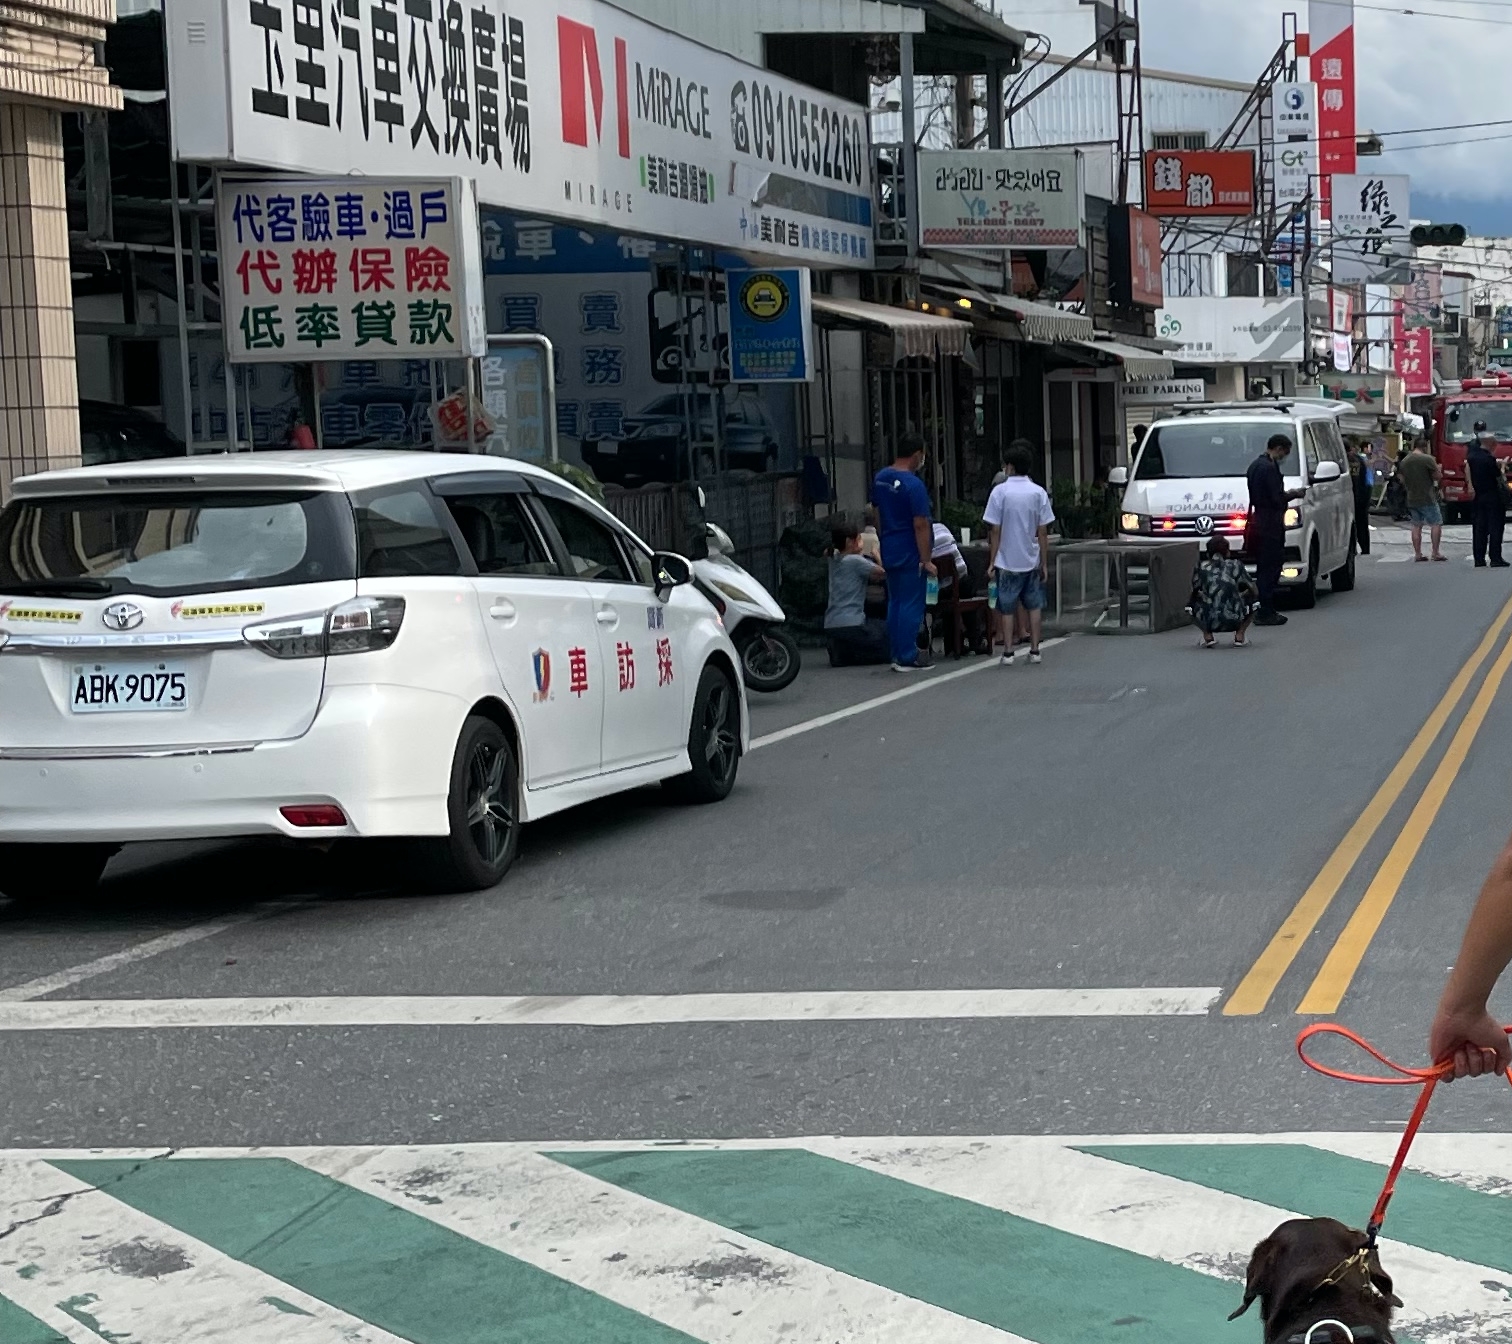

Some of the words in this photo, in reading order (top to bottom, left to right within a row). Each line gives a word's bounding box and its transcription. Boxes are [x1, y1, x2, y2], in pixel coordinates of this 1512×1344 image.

[751, 80, 862, 187] 0910552260
[563, 179, 634, 214] MIRAGE
[236, 248, 452, 295] 代辦保險
[239, 301, 455, 350] 低率貸款
[1122, 385, 1149, 395] FREE
[1153, 383, 1202, 394] PARKING
